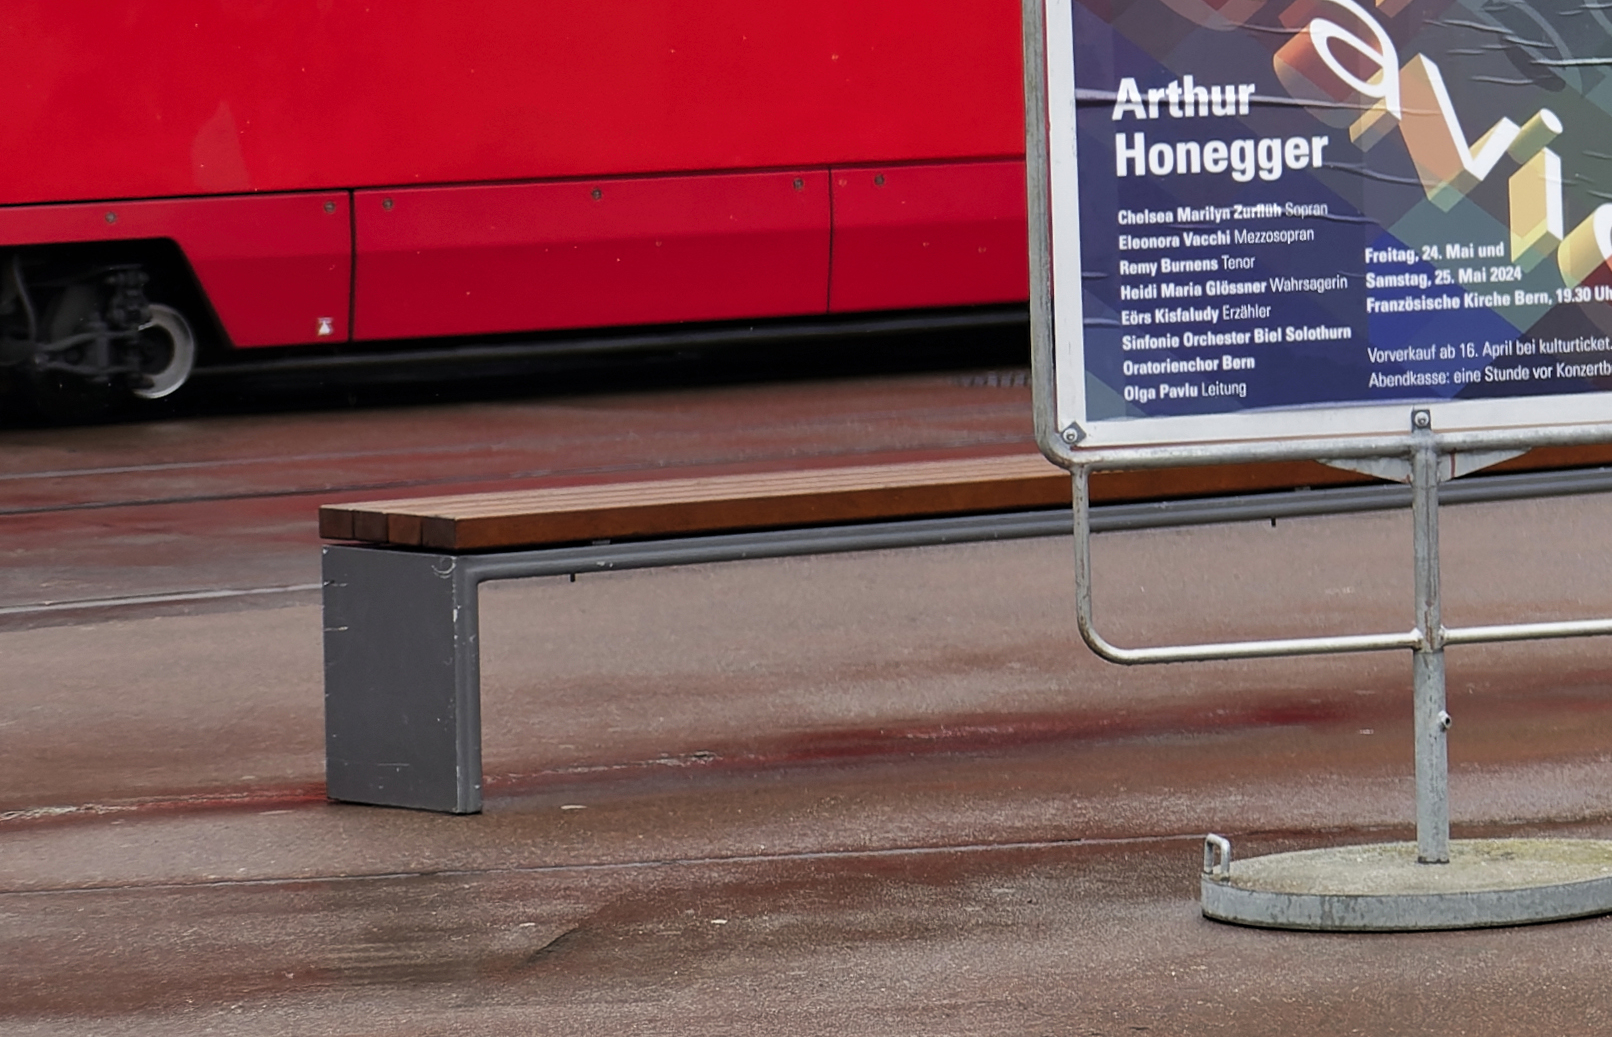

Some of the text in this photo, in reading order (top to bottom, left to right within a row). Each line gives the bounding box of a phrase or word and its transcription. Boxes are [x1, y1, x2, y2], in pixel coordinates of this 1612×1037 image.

[1111, 74, 1256, 121] Arthur
[1114, 131, 1329, 182] Honegger
[1117, 208, 1174, 225] Chelsea
[1176, 205, 1231, 223] Marilyn
[1284, 201, 1328, 219] Sopran
[1118, 228, 1315, 250] Eleonora Vacchi Mezzosopran
[1364, 241, 1505, 265] Freitag, 24. Mai und
[1119, 254, 1255, 277] Remy Burnens Tenor
[1365, 265, 1522, 289] Samstag, 25. Mai 2024
[1120, 274, 1348, 300] Heidi Maria Glössner Wahrsagerin
[1366, 293, 1461, 313] Französische
[1463, 291, 1511, 308] Kirche
[1513, 289, 1552, 306] Bern,
[1555, 286, 1592, 303] 19.30
[1121, 303, 1272, 326] Eörs Kisfaludy Erzähler
[1121, 324, 1352, 351] Sinfonie Orchester Biel Solothurn
[1367, 344, 1436, 363] Vorverkauf
[1439, 343, 1456, 359] ab
[1459, 342, 1478, 358] 16.
[1482, 339, 1512, 360] April
[1515, 338, 1536, 356] bei
[1122, 354, 1255, 376] Oratorienchor Bern
[1368, 370, 1450, 388] Abendkasse:
[1452, 367, 1481, 384] eine
[1484, 364, 1530, 382] Stunde
[1531, 366, 1553, 379] vor
[1123, 380, 1247, 403] Olga Pavlu Leitung
